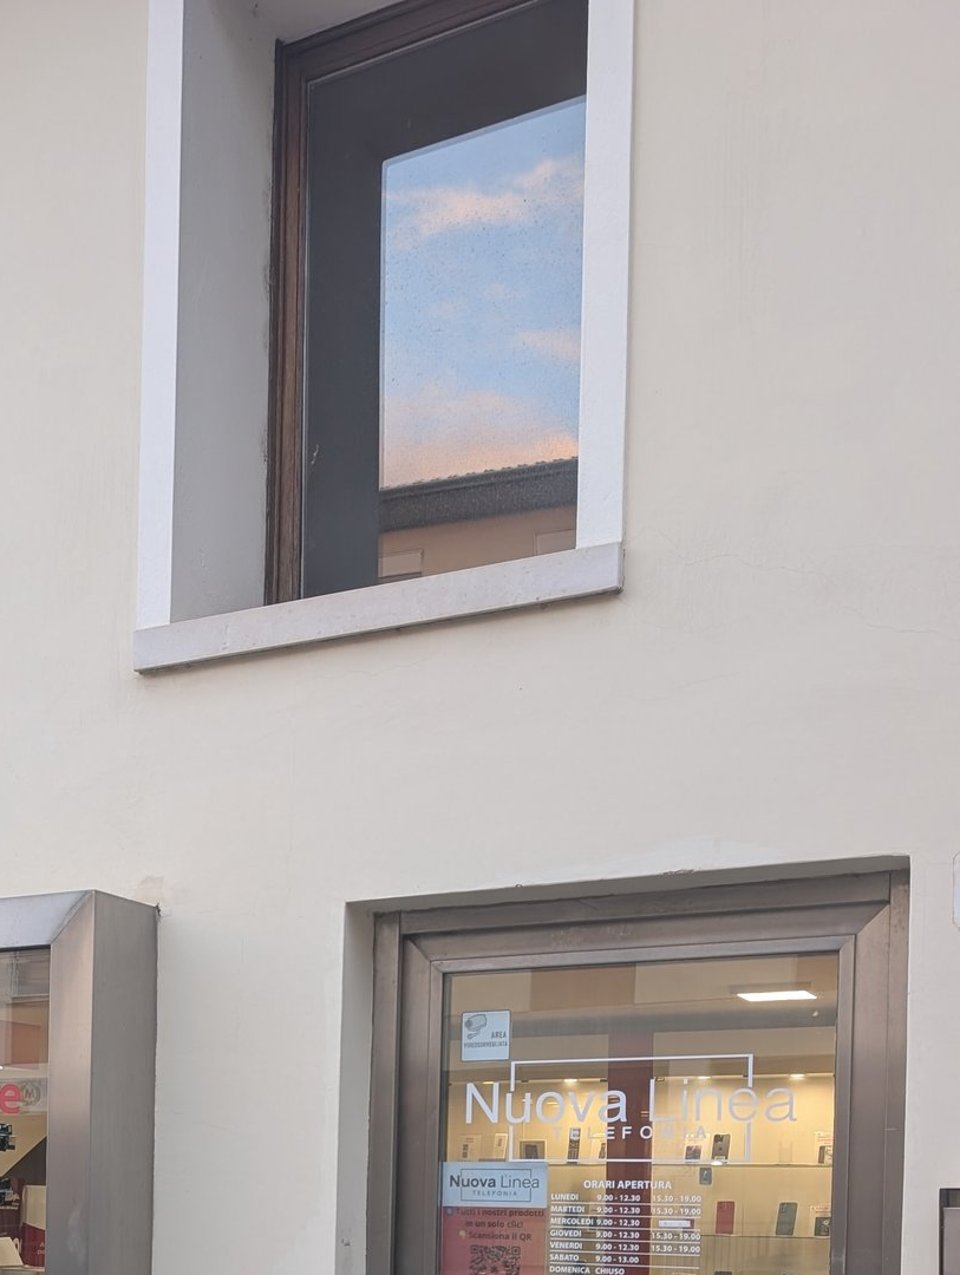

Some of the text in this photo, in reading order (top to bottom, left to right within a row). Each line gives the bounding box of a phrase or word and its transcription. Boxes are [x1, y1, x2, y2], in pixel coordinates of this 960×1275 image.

[491, 1031, 506, 1039] AREA
[465, 1078, 796, 1125] Nuova Linea
[450, 1174, 540, 1189] Nuova Linea
[583, 1179, 672, 1190] ORARI APERTURA
[550, 1193, 578, 1201] LUNEDI
[597, 1194, 613, 1202] 9.00
[620, 1194, 640, 1202] 12.30
[681, 1195, 701, 1203] 19.00
[508, 1209, 544, 1217] prodotti
[550, 1205, 585, 1213] MARTEDI
[597, 1206, 613, 1214] 9.00
[620, 1206, 640, 1214] 12.30
[651, 1207, 672, 1215] 15.30
[487, 1220, 505, 1228] solo
[550, 1217, 595, 1226] MERCOLEDI
[596, 1219, 612, 1227] 9.00
[468, 1231, 510, 1240] Scansiona
[519, 1233, 532, 1241] QR
[550, 1229, 582, 1238] GIOVEDI
[596, 1231, 612, 1239] 9.00
[679, 1233, 701, 1241] 19.00
[549, 1242, 582, 1250] VENERDI
[651, 1245, 672, 1253] 15.30
[549, 1254, 579, 1262] SABATO
[549, 1266, 625, 1275] DOMENICA CHIUSO
